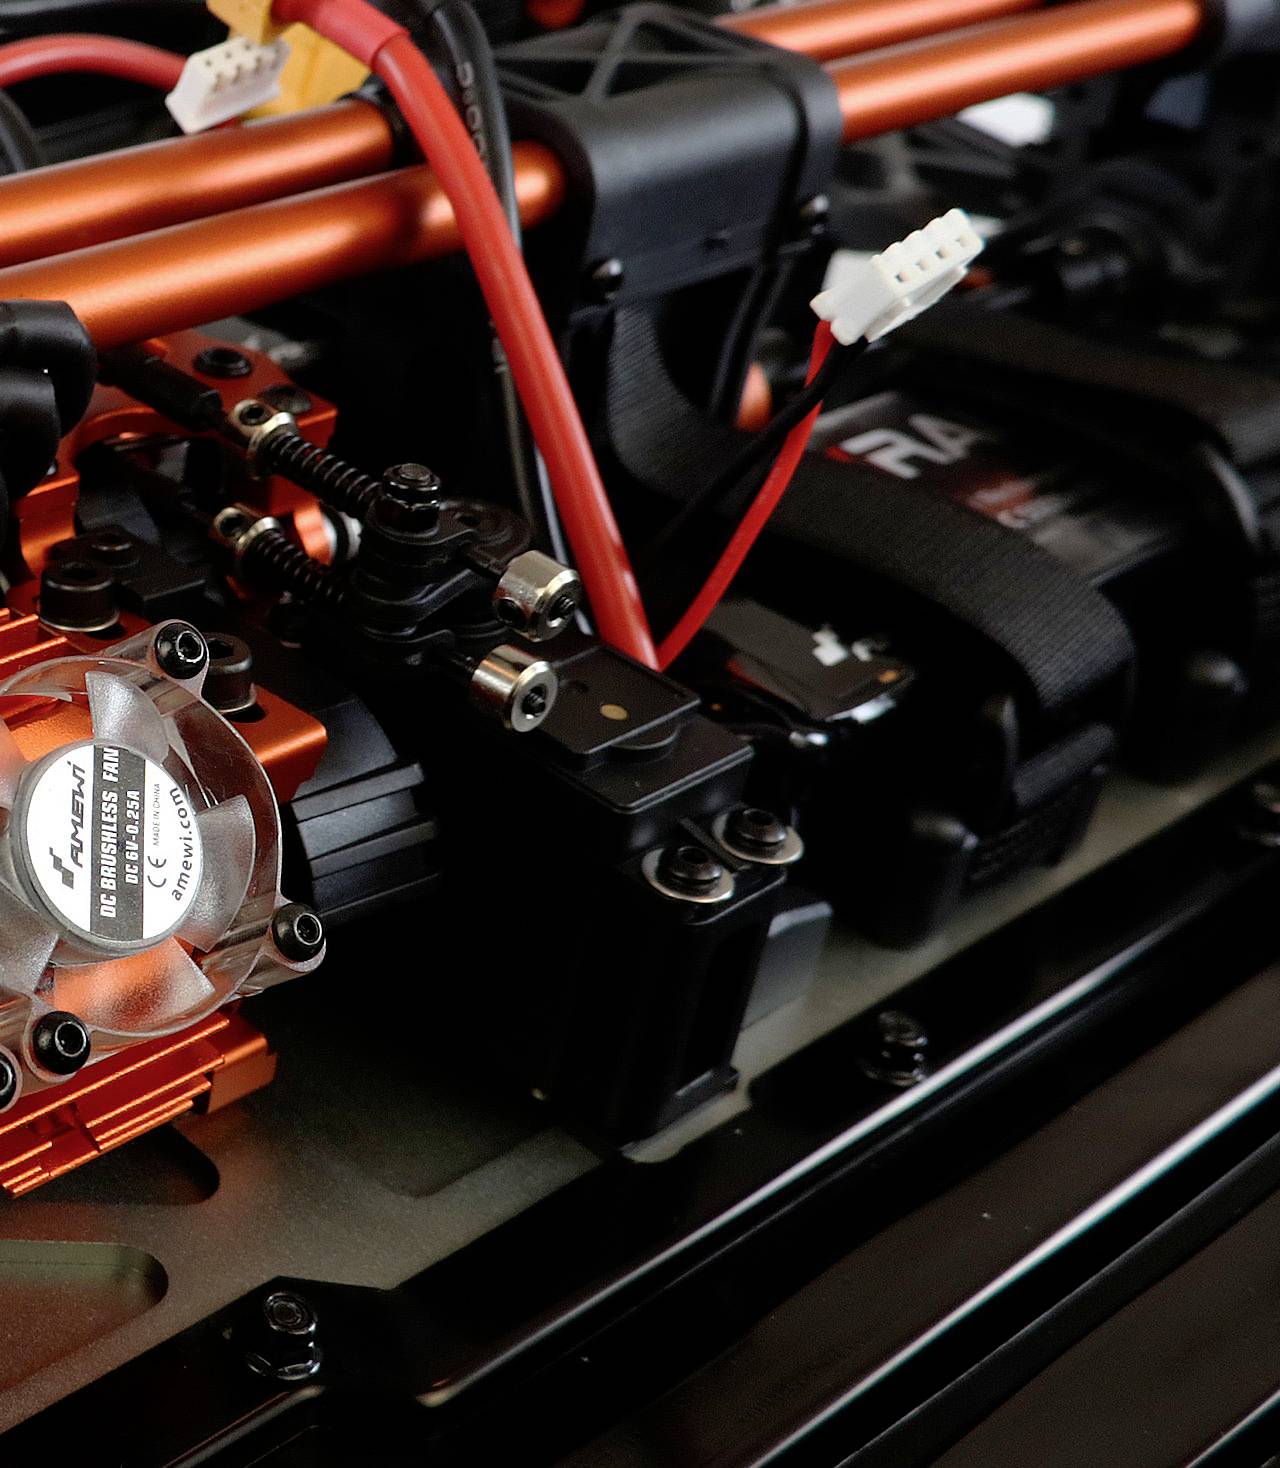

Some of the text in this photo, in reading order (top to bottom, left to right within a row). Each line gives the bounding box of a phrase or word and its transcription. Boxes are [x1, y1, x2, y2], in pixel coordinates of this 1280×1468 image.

[100, 747, 120, 918] DC BRUSHLESS FAN
[169, 787, 193, 901] amewi.com
